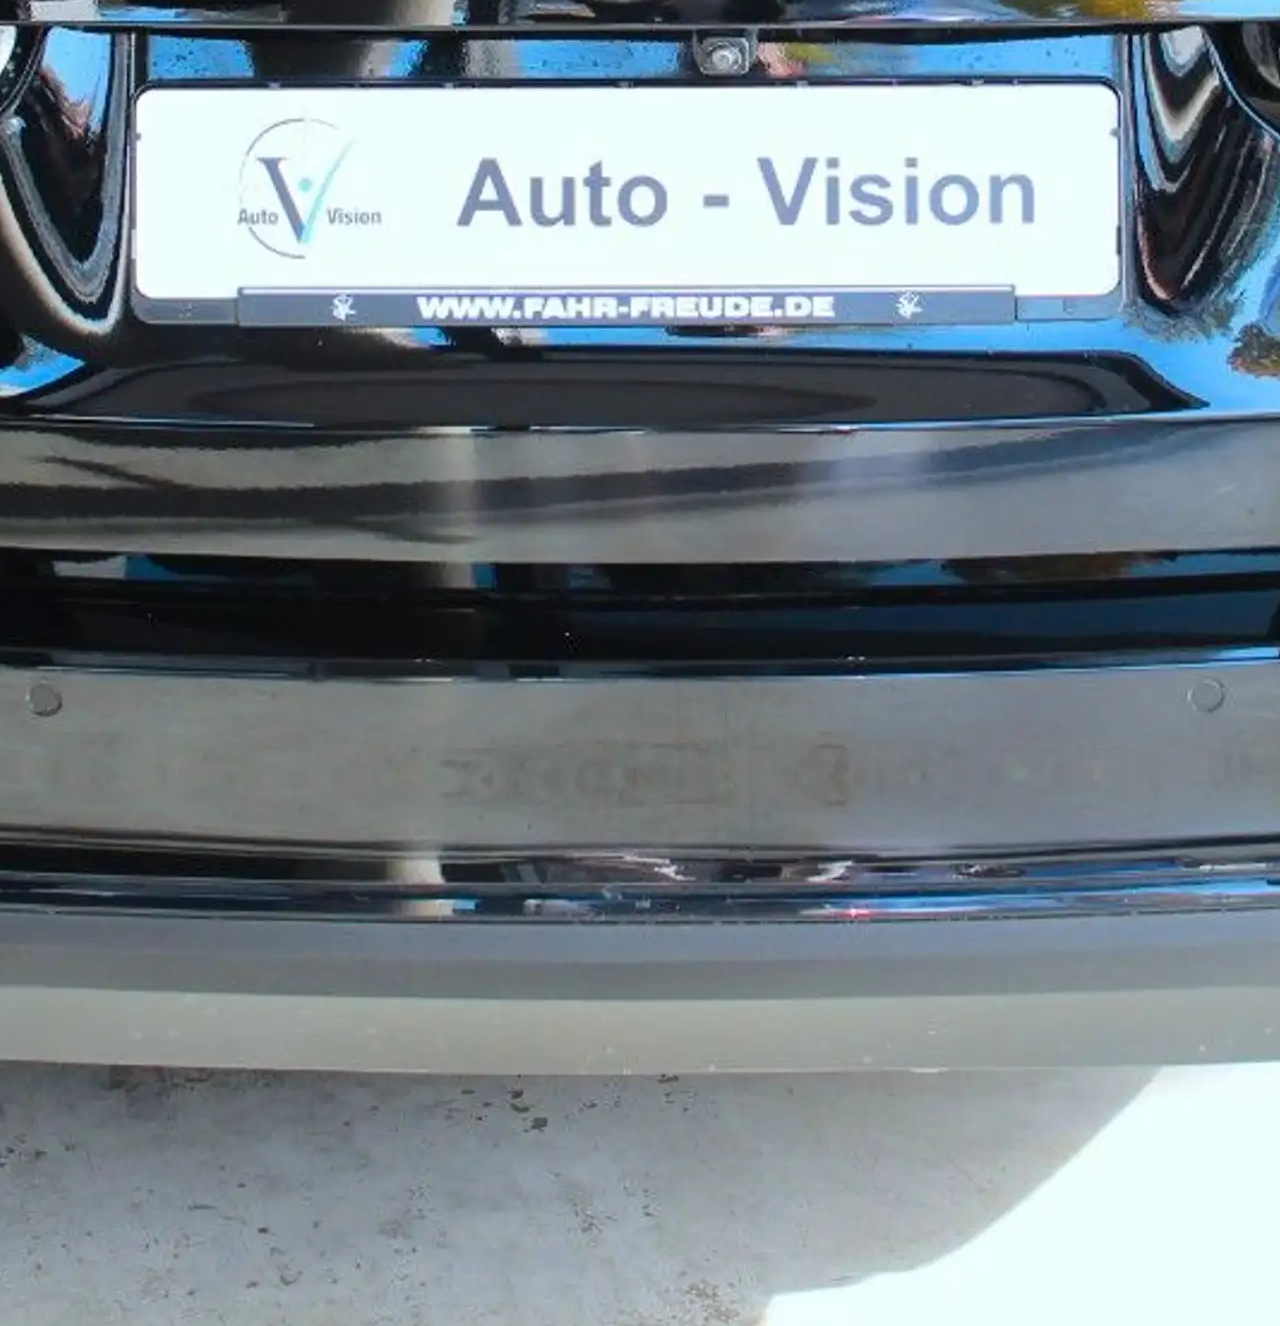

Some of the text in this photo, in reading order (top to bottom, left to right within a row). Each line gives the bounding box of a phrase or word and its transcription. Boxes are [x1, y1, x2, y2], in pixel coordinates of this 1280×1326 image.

[456, 157, 668, 228] Auto
[756, 156, 1035, 227] Vision
[237, 207, 383, 225] Auto Vision
[416, 295, 836, 320] WWW.FAHR-FREUDE.DE
